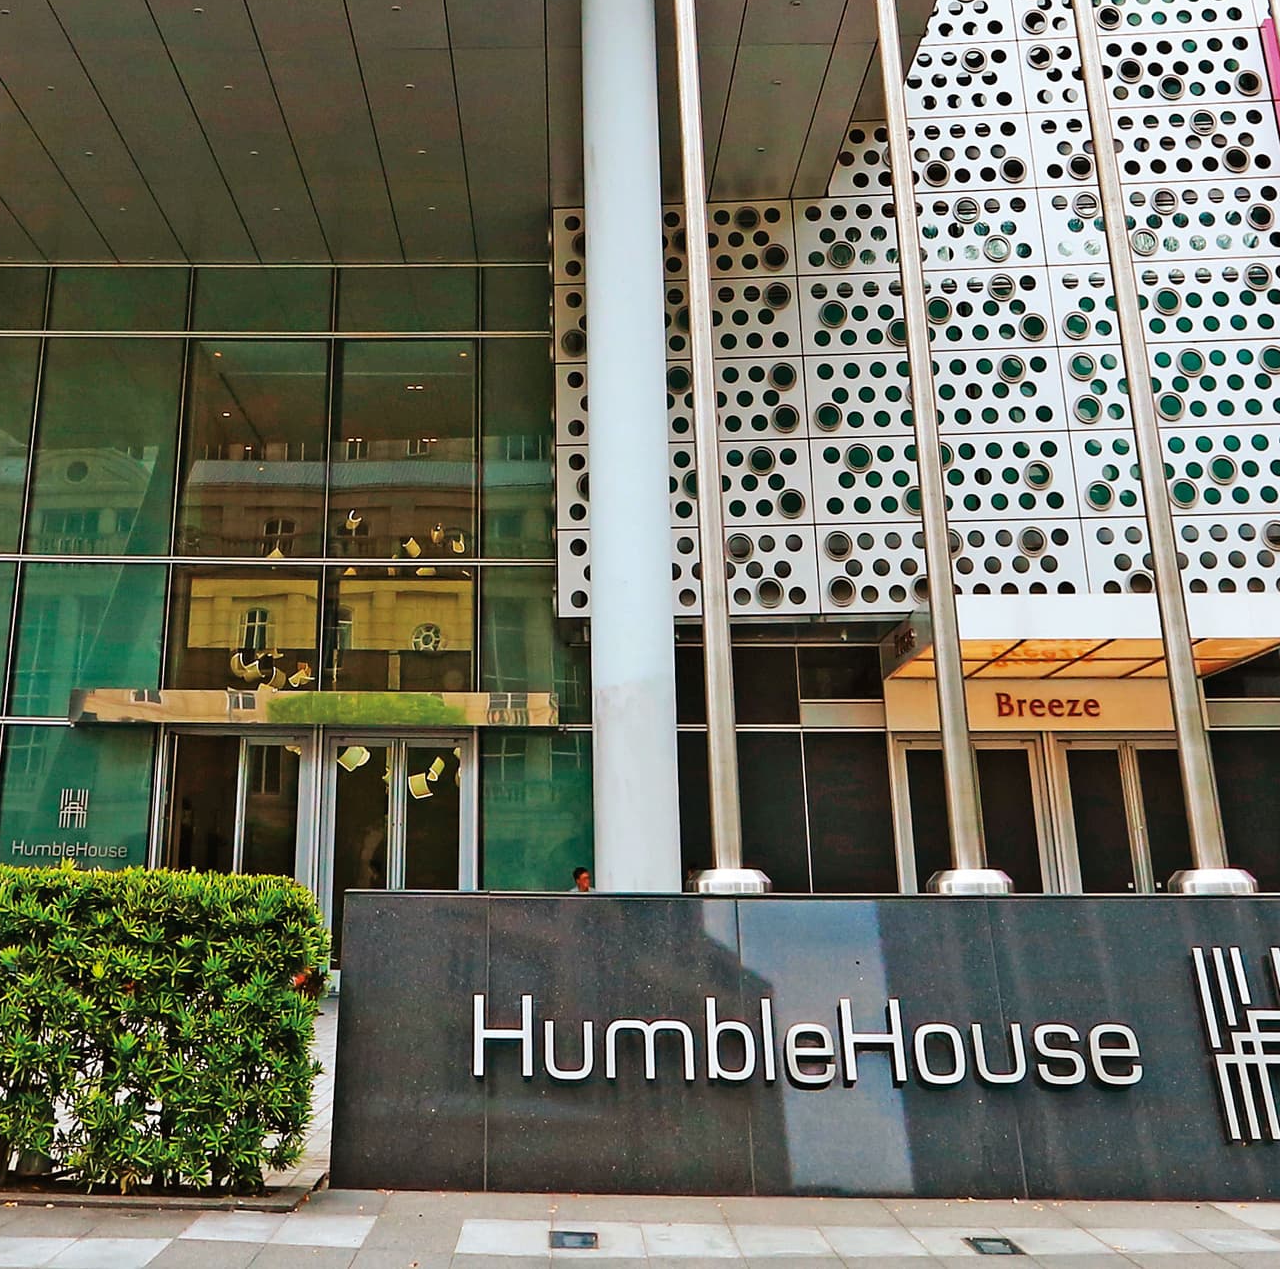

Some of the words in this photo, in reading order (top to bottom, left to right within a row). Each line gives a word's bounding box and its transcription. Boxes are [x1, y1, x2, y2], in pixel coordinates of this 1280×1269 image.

[995, 692, 1101, 717] Breeze
[11, 840, 128, 858] HumbleHouse
[473, 994, 1143, 1085] HumbleHouse
